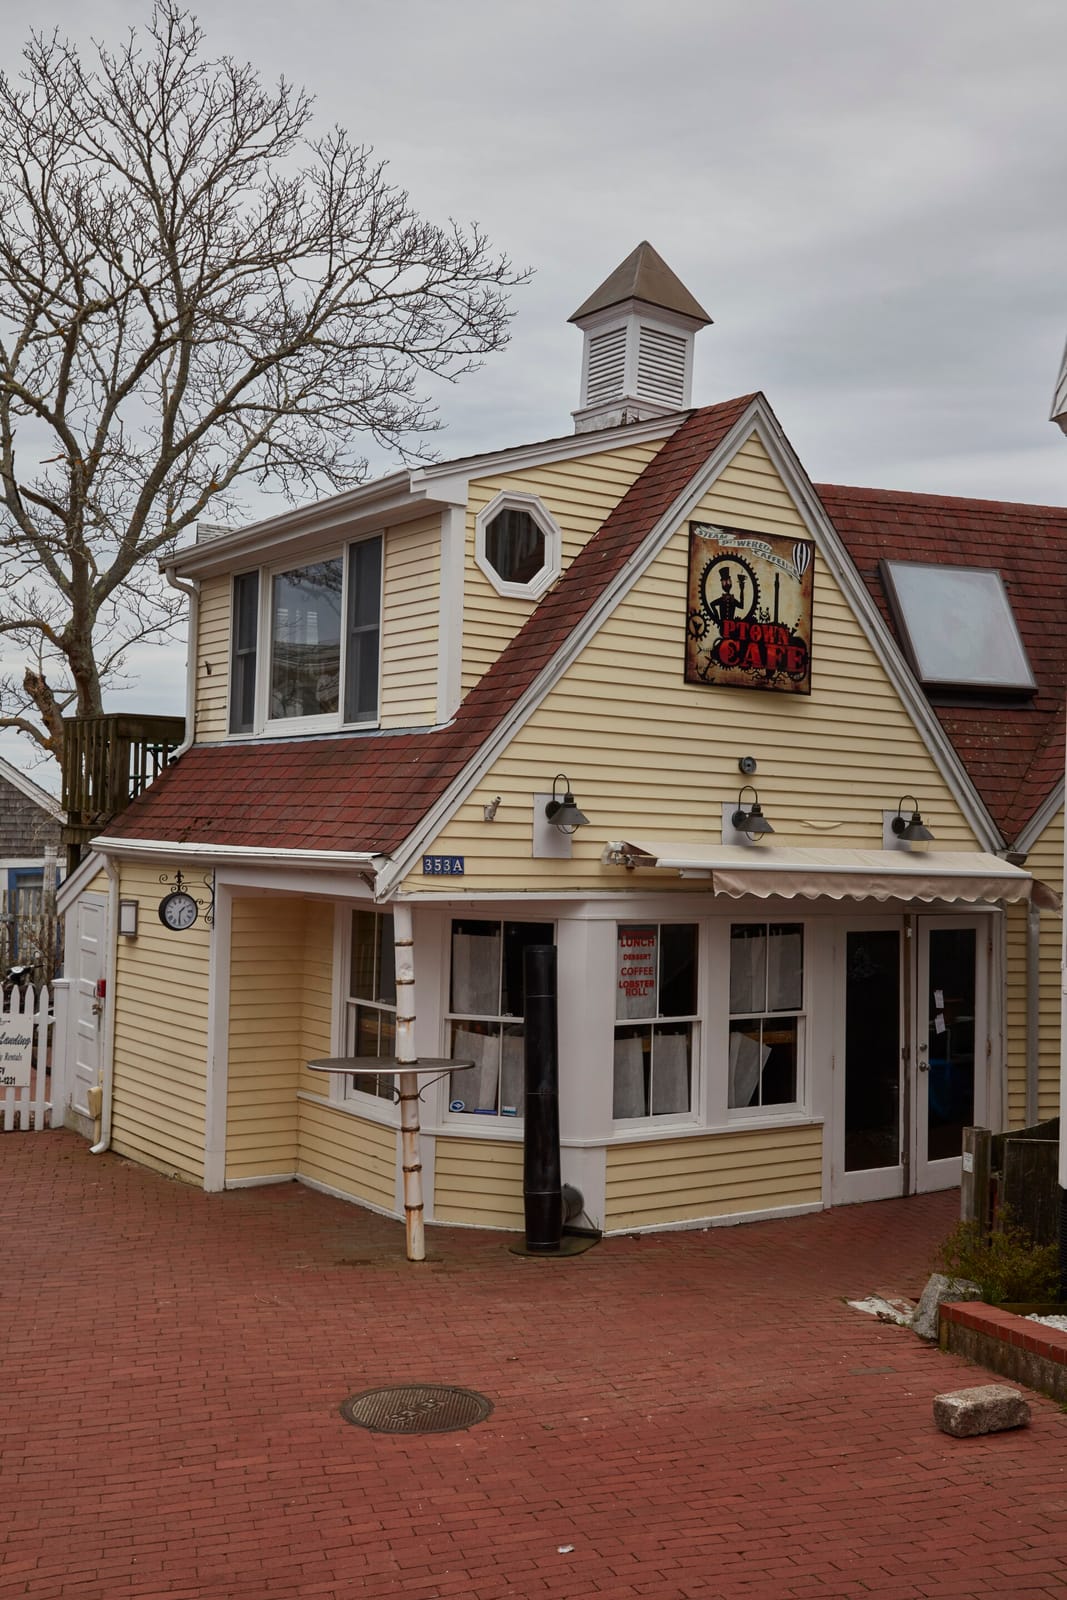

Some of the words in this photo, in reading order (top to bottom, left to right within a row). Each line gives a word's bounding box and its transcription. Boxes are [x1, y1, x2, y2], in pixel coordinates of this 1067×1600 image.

[698, 530, 728, 541] STEAM
[722, 619, 791, 646] PTOWN
[718, 639, 806, 674] CAFE
[424, 858, 463, 872] 353A
[620, 937, 655, 948] LUNCH
[623, 953, 652, 961] DESSERT
[620, 966, 654, 976] COFFEE
[618, 979, 655, 989] LOBSTER
[625, 988, 649, 997] ROLL
